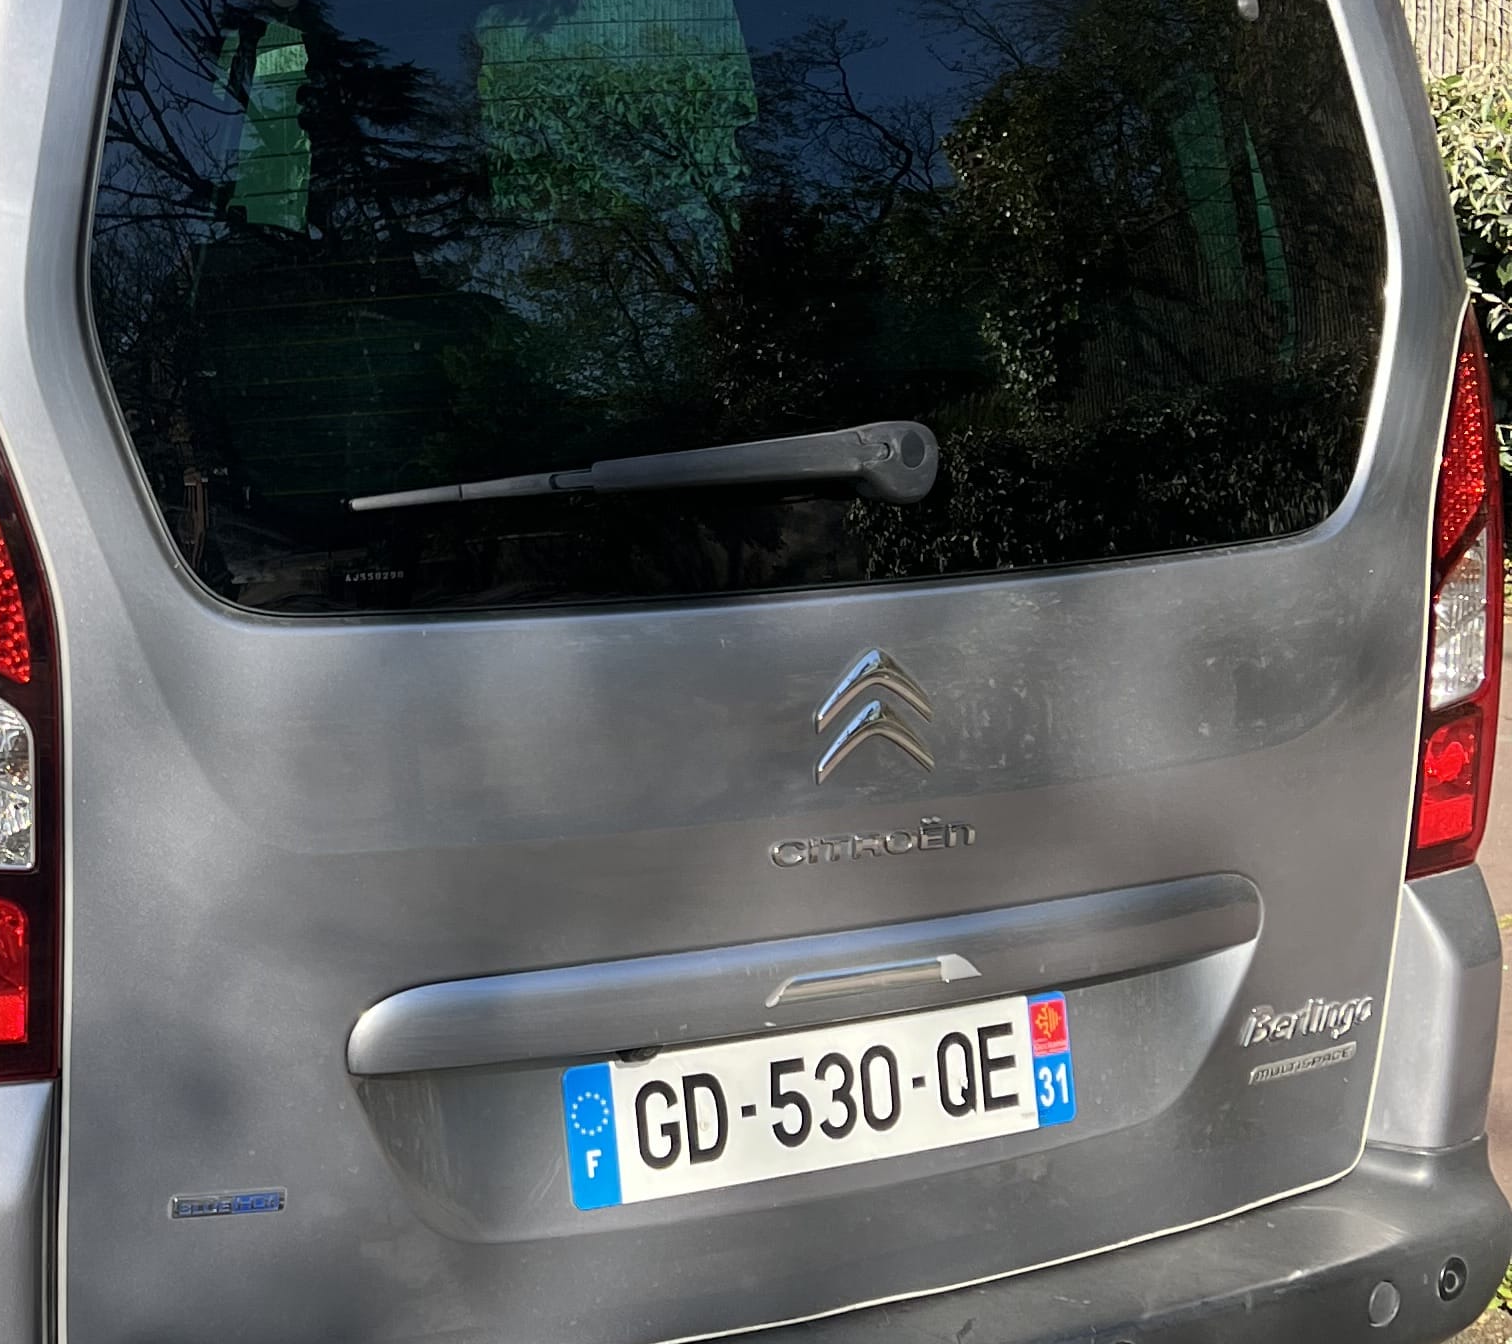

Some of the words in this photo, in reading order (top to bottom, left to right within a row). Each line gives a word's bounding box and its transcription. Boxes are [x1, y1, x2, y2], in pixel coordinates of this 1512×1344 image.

[1240, 996, 1373, 1047] Berlingo
[586, 1148, 602, 1179] F
[634, 1021, 1020, 1171] GD-530-QE
[1038, 1062, 1070, 1107] 31
